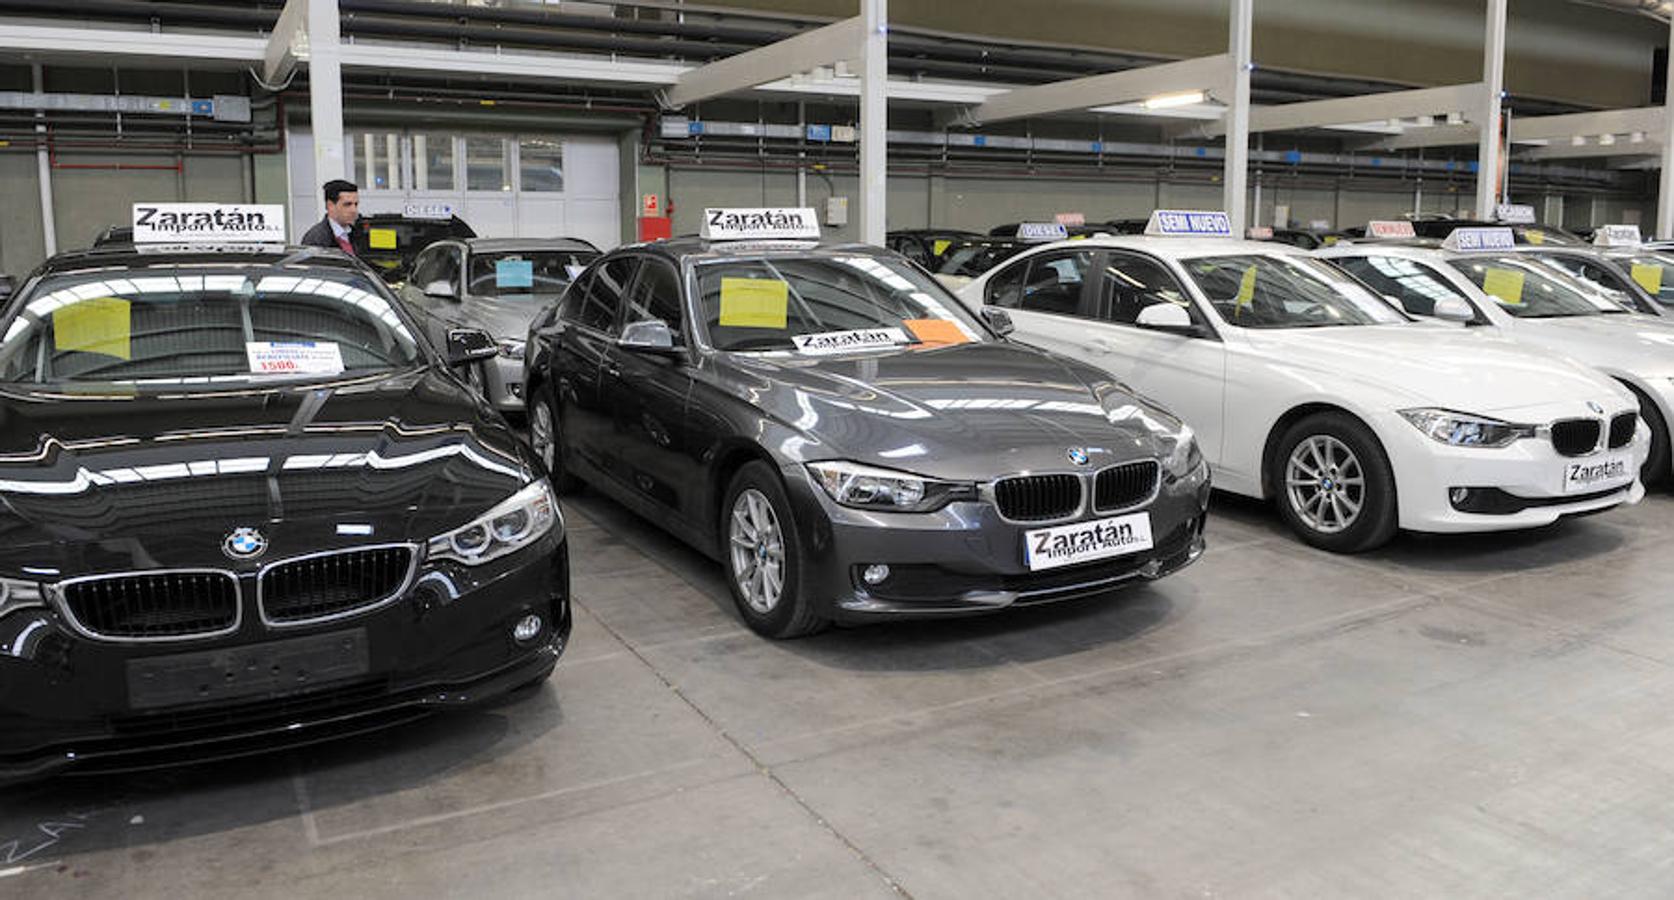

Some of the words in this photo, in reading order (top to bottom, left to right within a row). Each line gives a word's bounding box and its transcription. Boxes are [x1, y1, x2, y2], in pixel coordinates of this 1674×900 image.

[136, 207, 265, 226] Zaratán
[708, 209, 803, 226] Zaratán
[1160, 214, 1190, 232] SEMI
[1189, 214, 1229, 232] NUEVO
[151, 221, 214, 233] Import
[222, 221, 265, 231] Auto
[720, 222, 767, 232] Import
[1458, 232, 1481, 248] SEMI
[1482, 231, 1513, 248] NUEVO
[803, 330, 889, 347] Zaratán
[1569, 459, 1624, 481] Zaratán
[1034, 520, 1132, 555] Zaratán
[1047, 540, 1098, 559] Import
[1102, 536, 1134, 549] Auto
